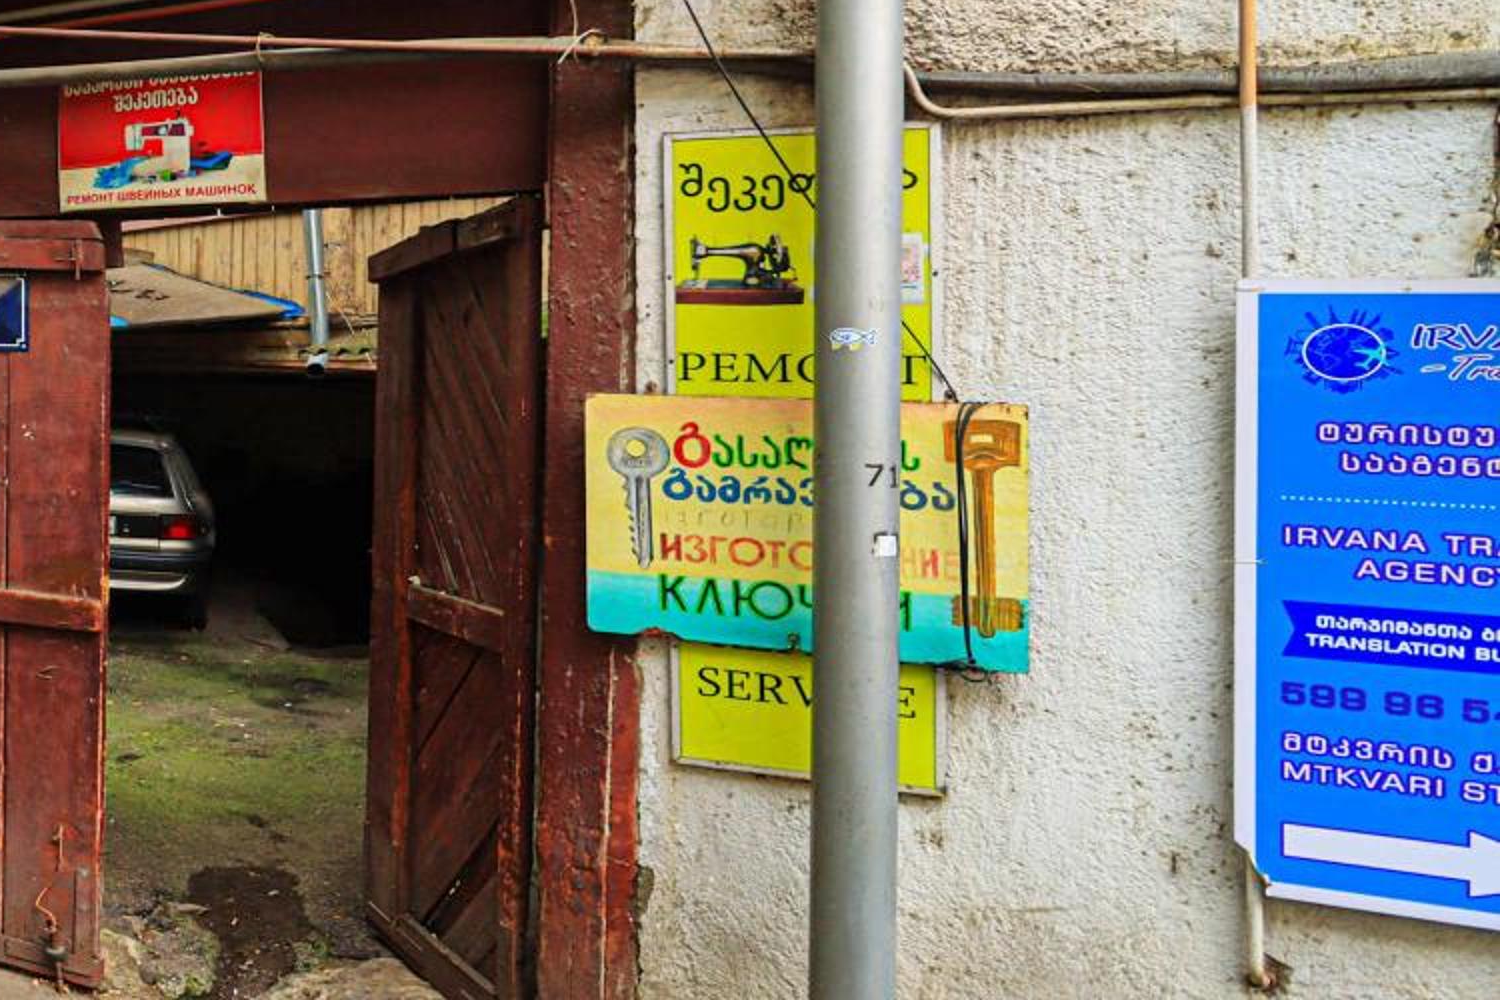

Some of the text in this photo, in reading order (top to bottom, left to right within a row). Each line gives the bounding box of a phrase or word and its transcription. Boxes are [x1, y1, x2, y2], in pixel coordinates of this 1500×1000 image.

[114, 86, 199, 113] შეკეთება
[67, 192, 114, 206] РЕМОНТ
[185, 182, 257, 197] МАШИНОК
[1411, 322, 1500, 350] IRV
[1283, 525, 1500, 558] IRVANA TR
[1355, 558, 1500, 587] AGENC
[1304, 632, 1466, 660] TRANSLATION
[1461, 698, 1500, 724] 5
[1282, 732, 1454, 770] მტკვრის
[1282, 760, 1445, 798] MTKVARI
